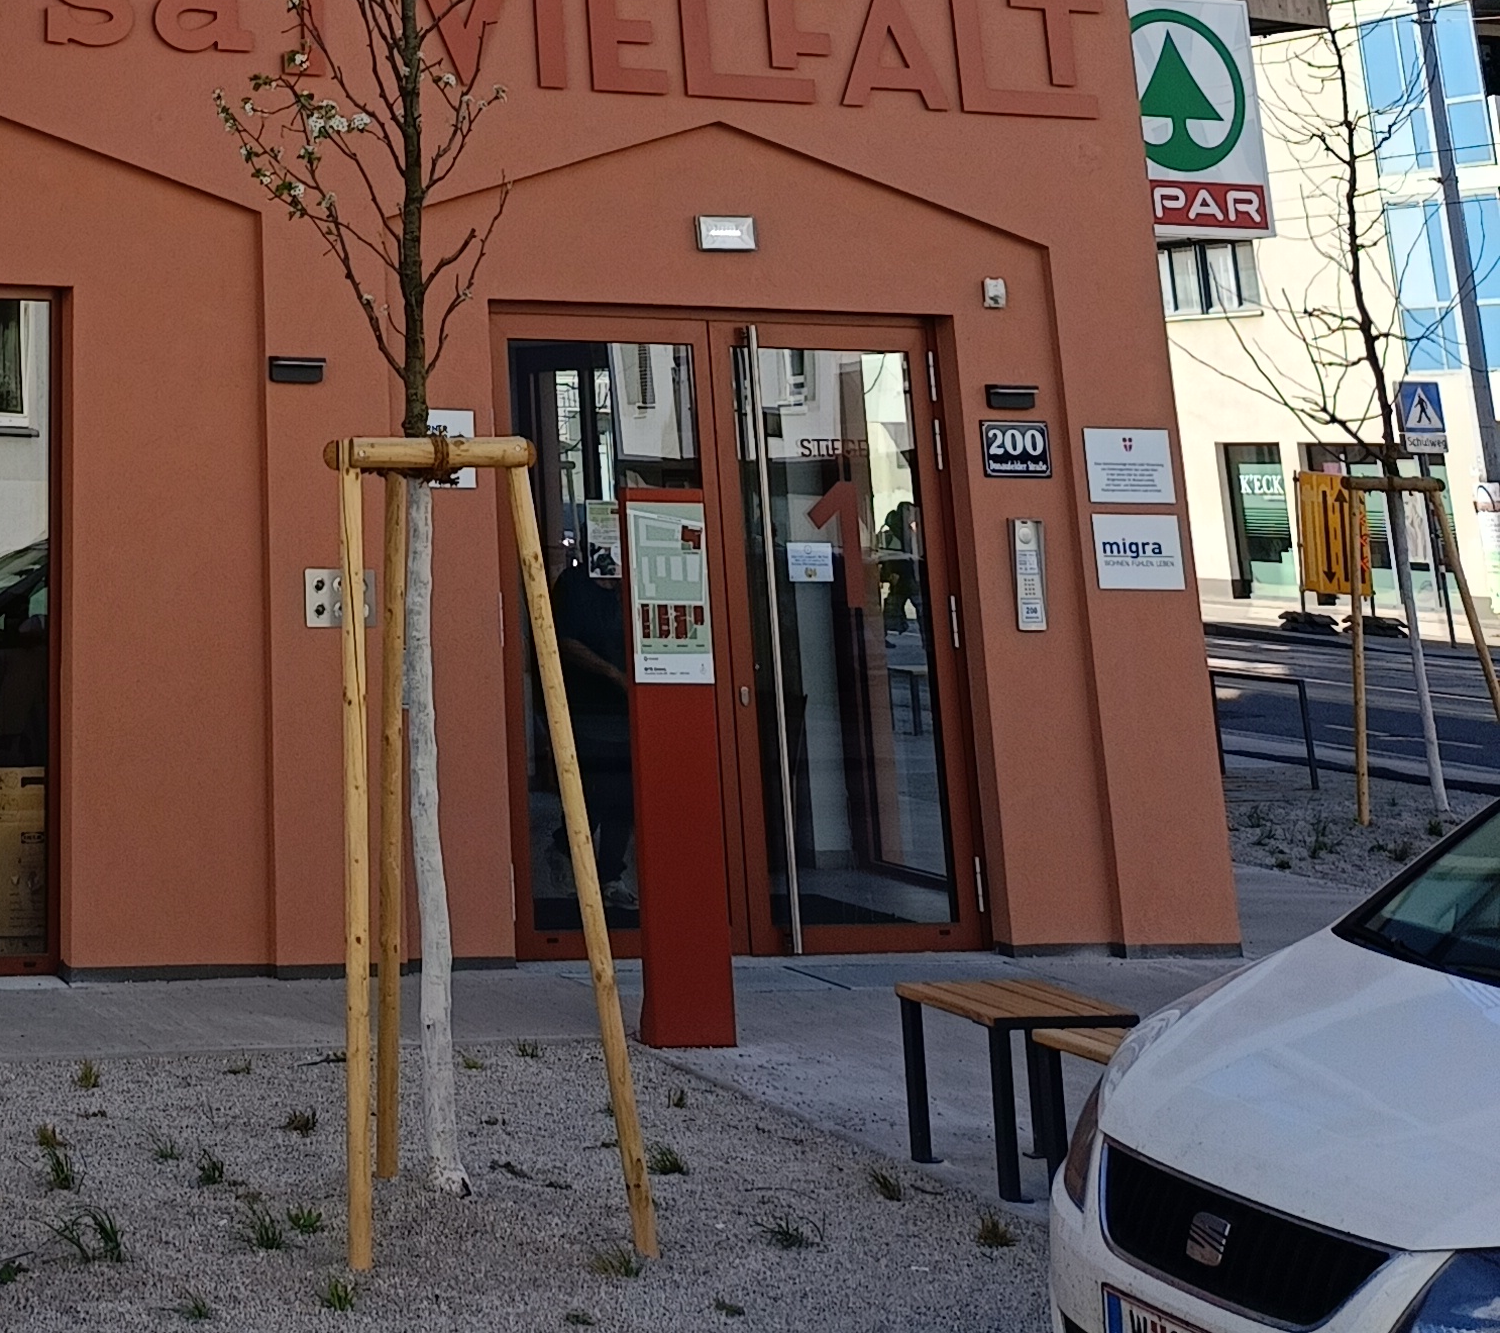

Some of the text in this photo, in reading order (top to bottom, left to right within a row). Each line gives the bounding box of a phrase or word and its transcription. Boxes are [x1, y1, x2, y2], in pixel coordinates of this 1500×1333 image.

[1152, 186, 1263, 224] PAR
[987, 428, 1044, 456] 200
[1406, 436, 1447, 450] Schulweg
[807, 480, 865, 608] 1
[1102, 538, 1163, 559] migra
